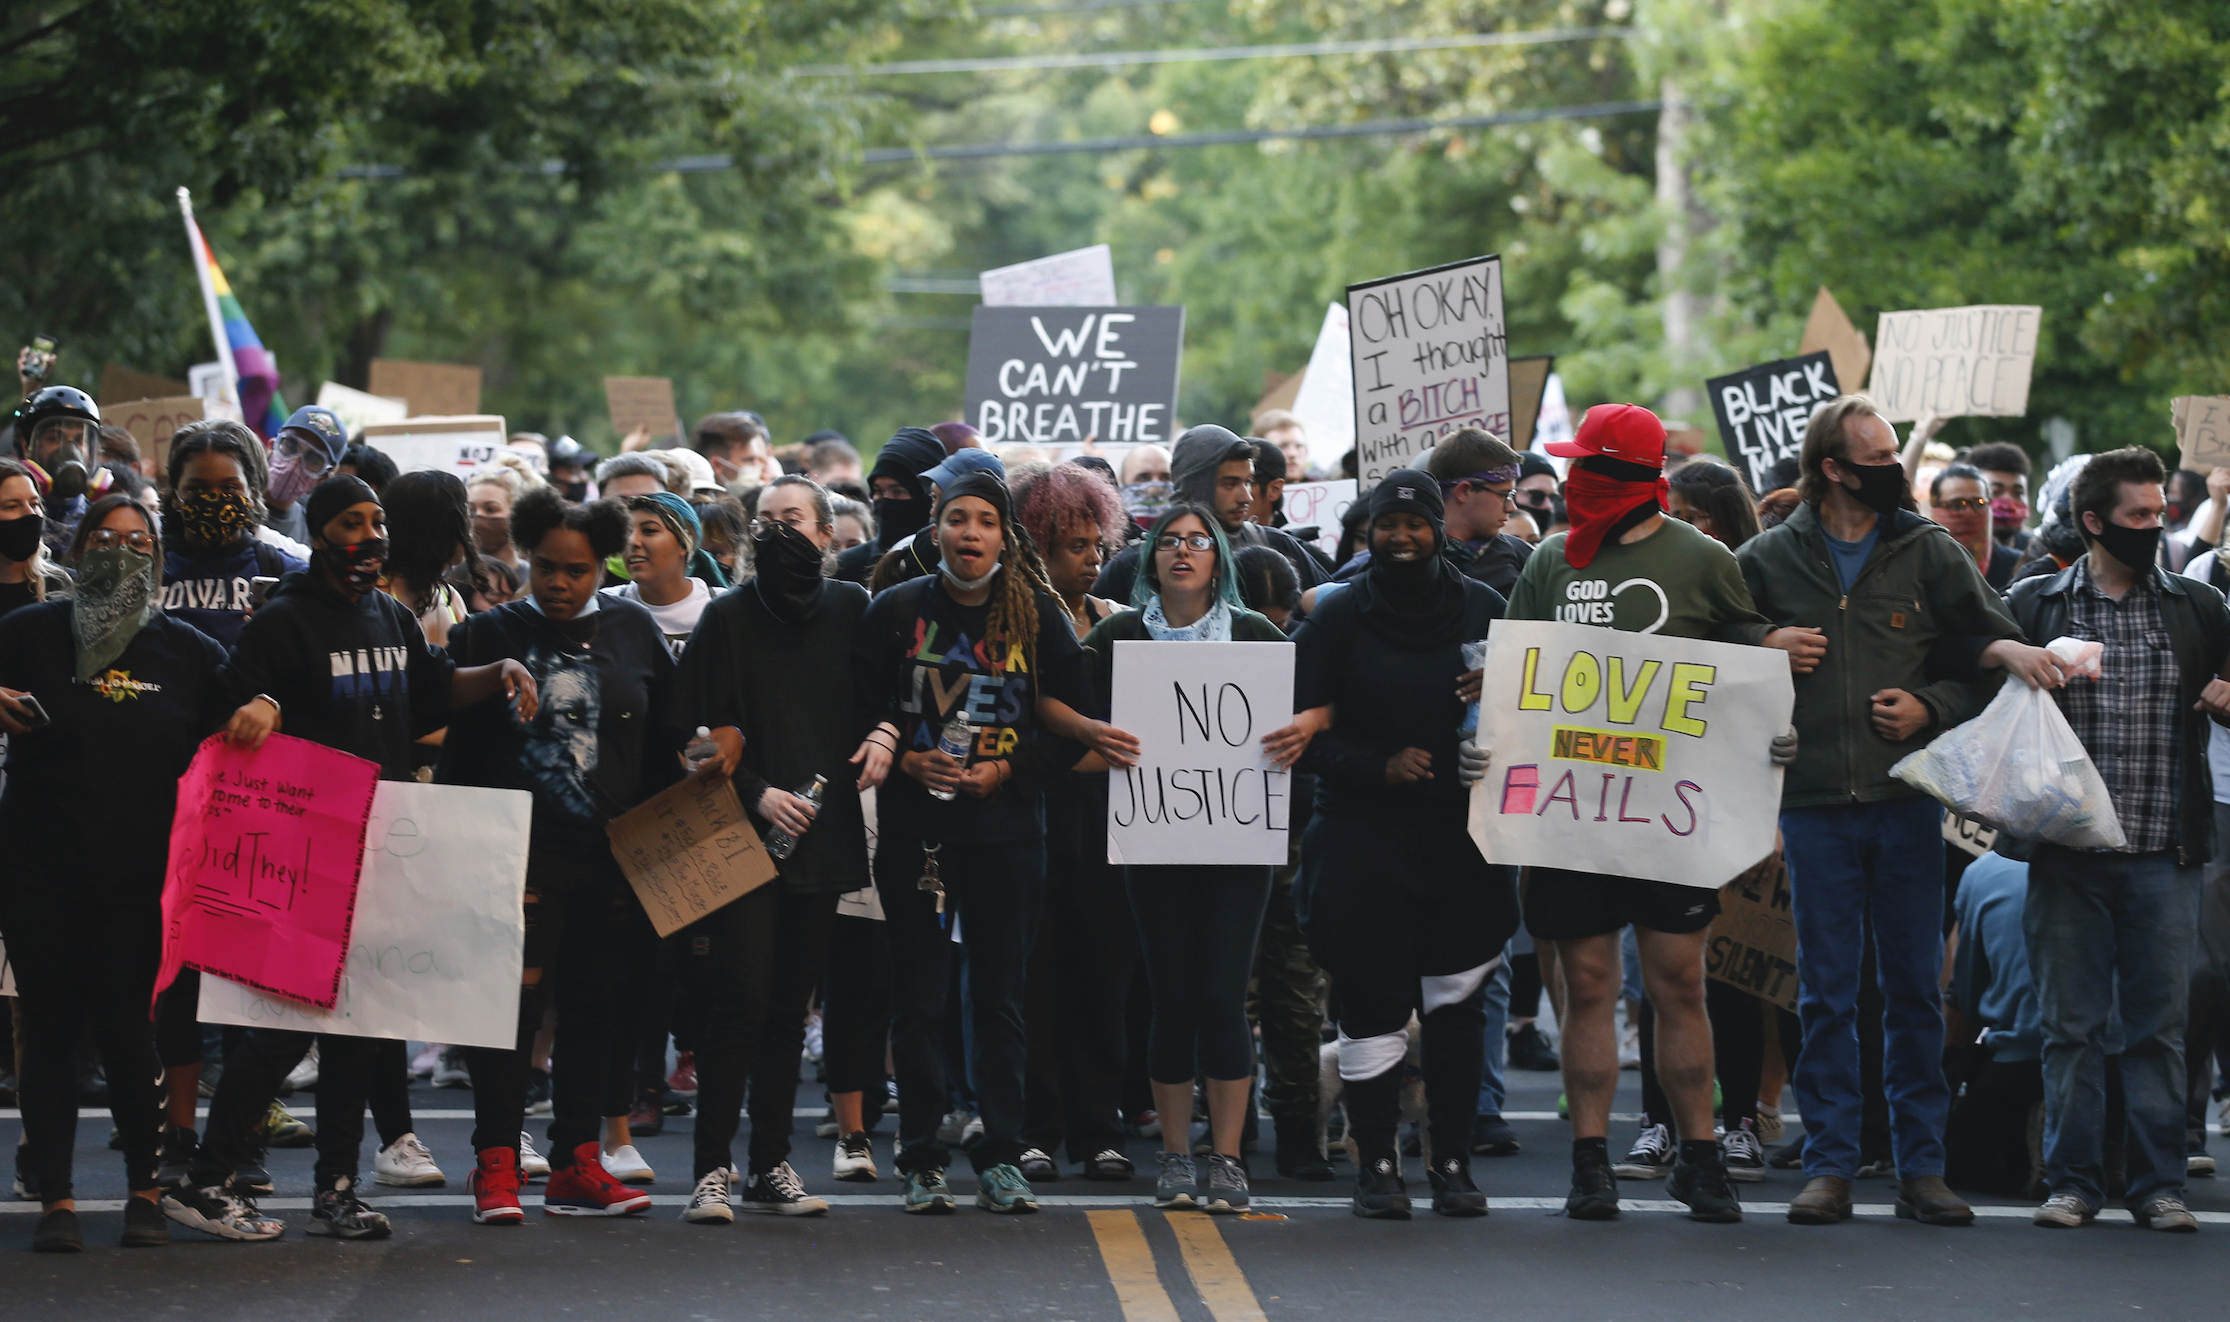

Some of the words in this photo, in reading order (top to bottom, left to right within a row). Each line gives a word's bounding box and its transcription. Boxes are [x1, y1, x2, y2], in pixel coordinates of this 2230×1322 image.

[1031, 313, 1136, 358] WE
[1359, 287, 1408, 343] OH
[1883, 314, 1922, 353] NO
[999, 359, 1138, 399] CAN'T
[1363, 350, 1395, 393] I
[1412, 323, 1507, 379] thought
[1368, 402, 1388, 425] a
[1398, 377, 1482, 427] BITCH
[1721, 361, 1838, 427] BLACK
[1875, 354, 1915, 411] NO
[1920, 353, 2018, 413] PEACE
[979, 400, 1166, 443] BREATHE
[2201, 405, 2220, 424] I
[1362, 433, 1411, 464] with
[1420, 430, 1435, 451] a
[1555, 602, 1615, 624] LOVES
[1565, 579, 1609, 601] GOD
[1173, 680, 1253, 747] NO
[1518, 647, 1717, 738] LOVE
[1553, 729, 1661, 769] NEVER
[1115, 766, 1289, 831] JUSTICE
[1500, 763, 1703, 836] FAILS
